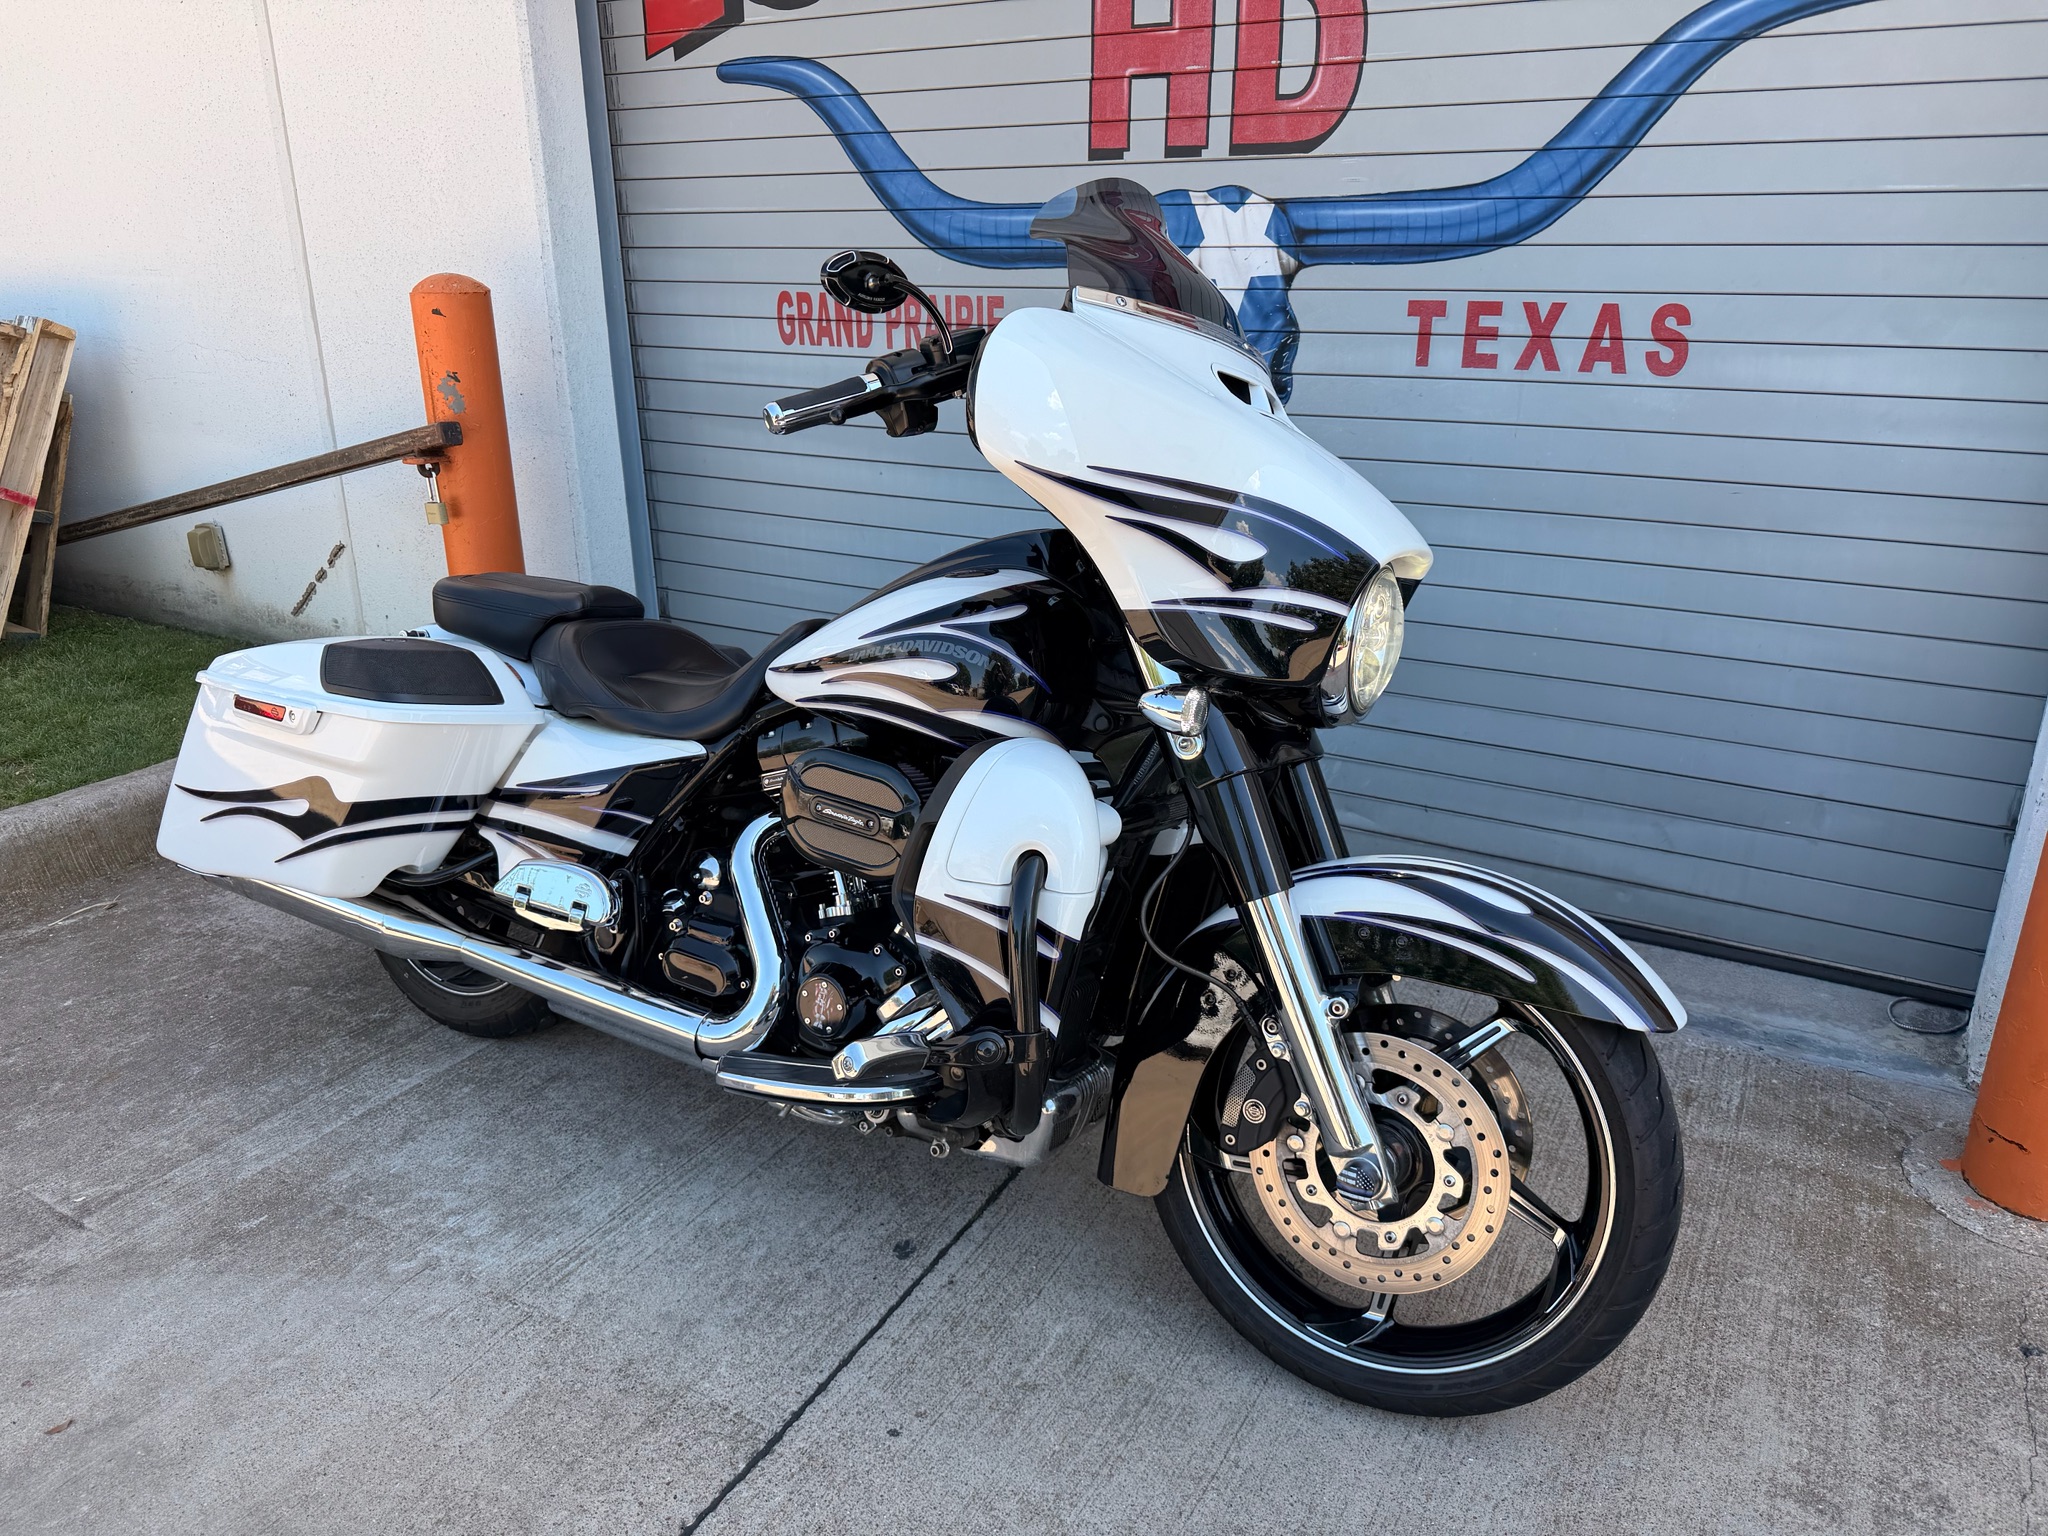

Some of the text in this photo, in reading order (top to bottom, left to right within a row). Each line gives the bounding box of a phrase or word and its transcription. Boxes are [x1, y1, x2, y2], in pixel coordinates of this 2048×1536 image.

[1088, 0, 1368, 160] HD
[777, 290, 873, 348] GRAND
[1407, 300, 1692, 377] TEXAS
